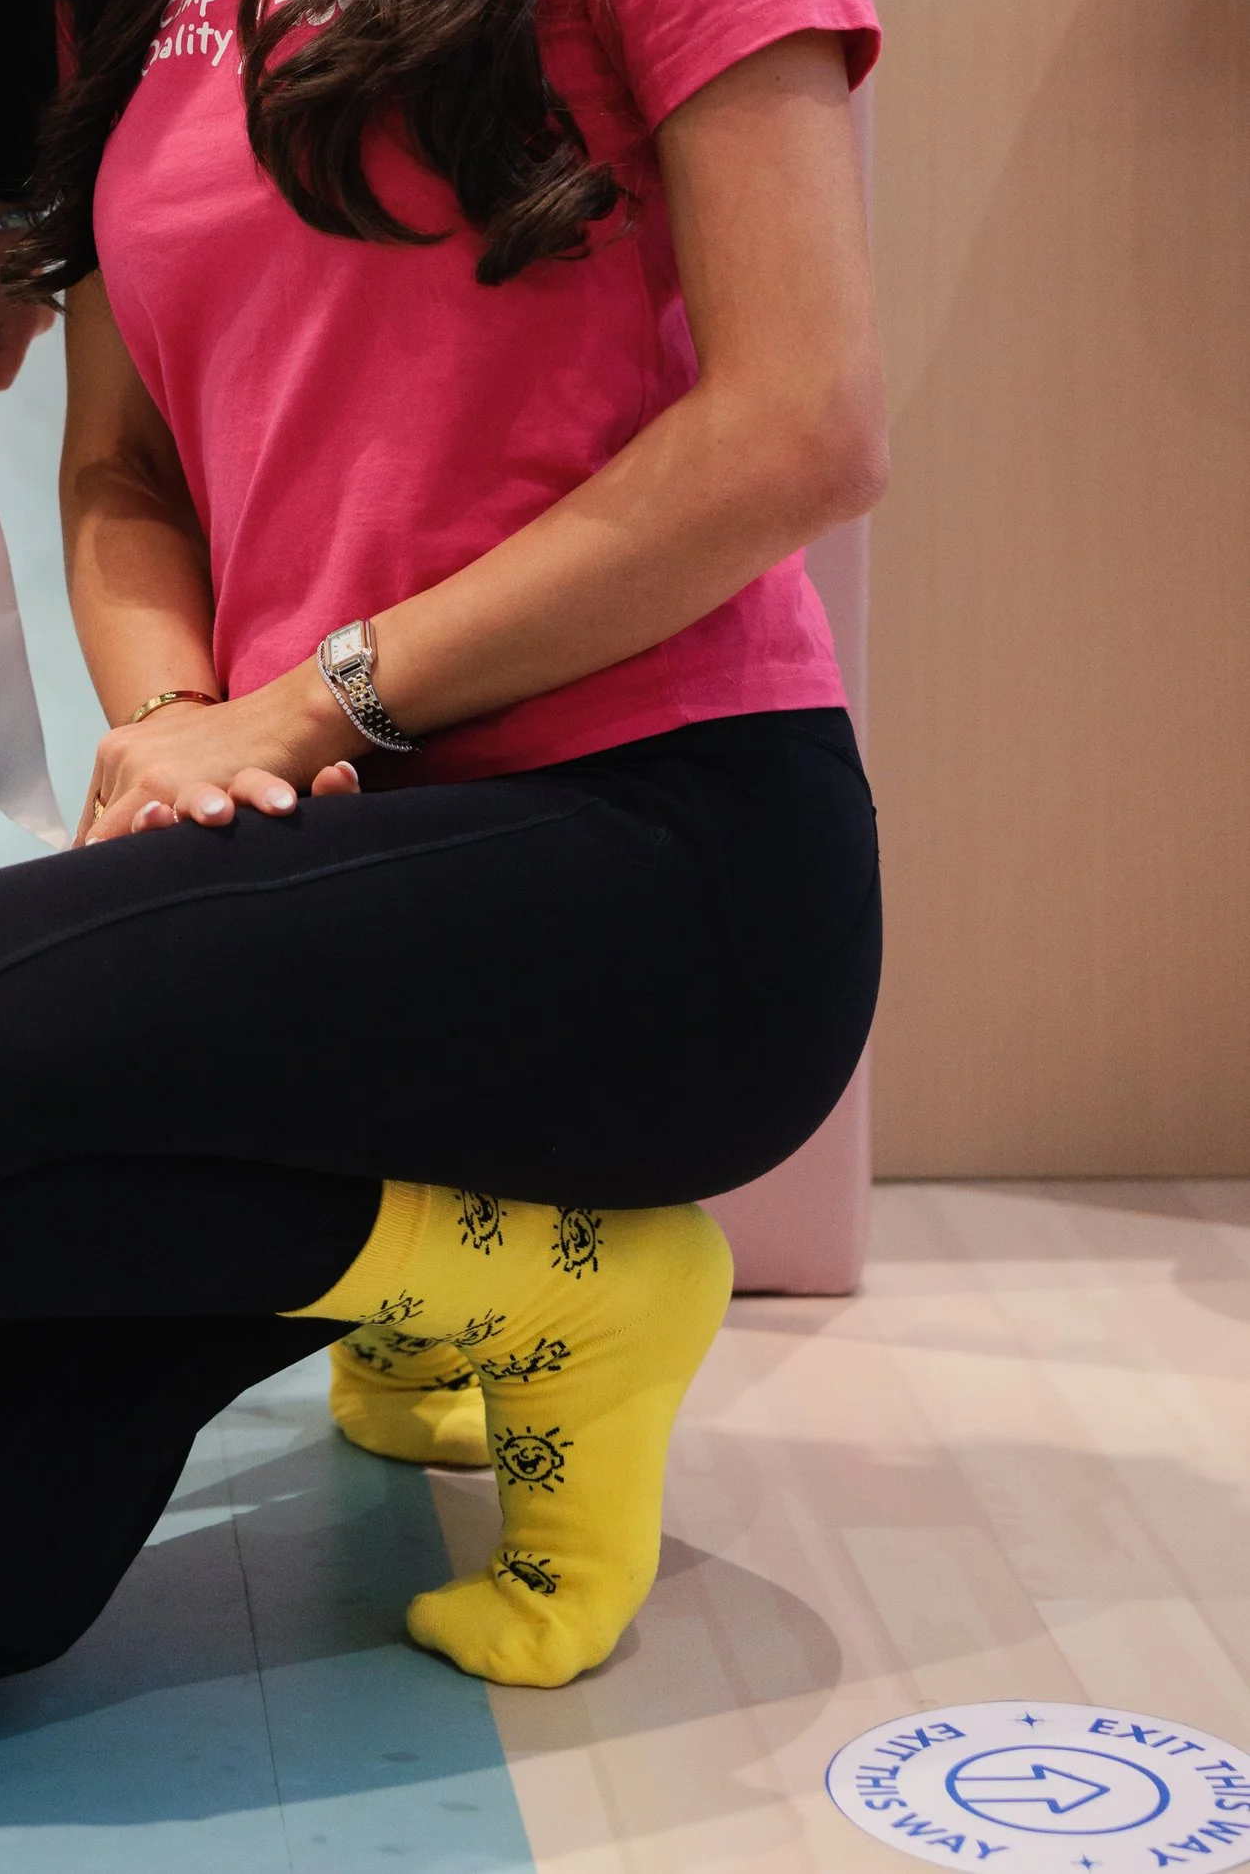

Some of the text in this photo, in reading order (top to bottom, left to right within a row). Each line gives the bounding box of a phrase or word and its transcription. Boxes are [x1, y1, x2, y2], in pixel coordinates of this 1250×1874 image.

[856, 1722, 1011, 1860] EXIT THIS WAY
[1087, 1718, 1250, 1867] EXIT THIS WAY
